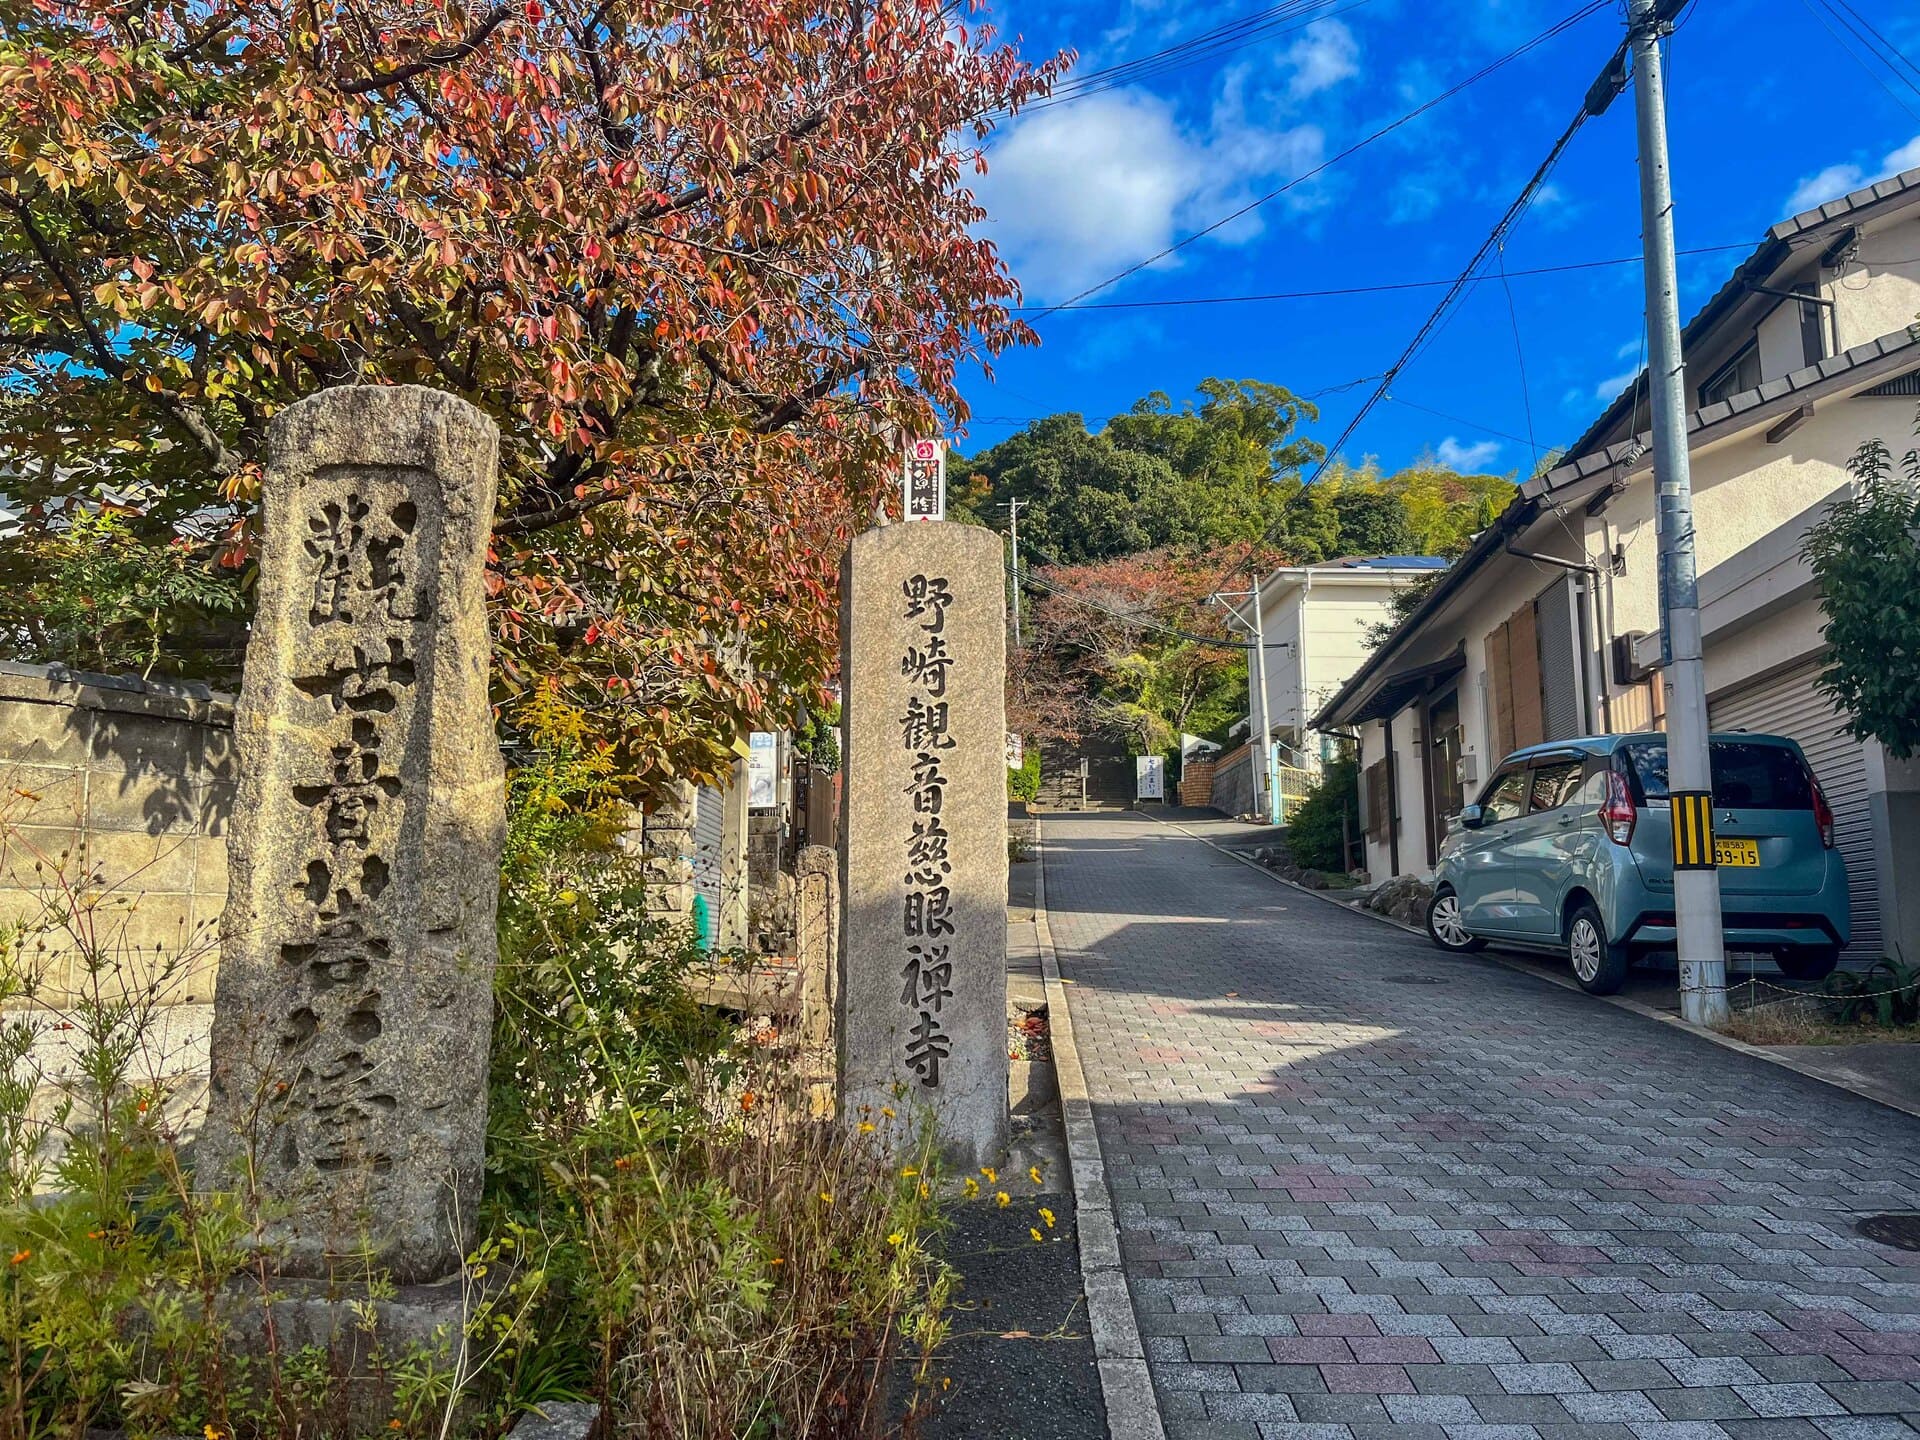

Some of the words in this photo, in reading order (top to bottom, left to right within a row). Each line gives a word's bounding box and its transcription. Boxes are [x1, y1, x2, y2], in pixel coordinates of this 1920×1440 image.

[898, 573, 957, 1088] 野崎観音慈眼禅寺
